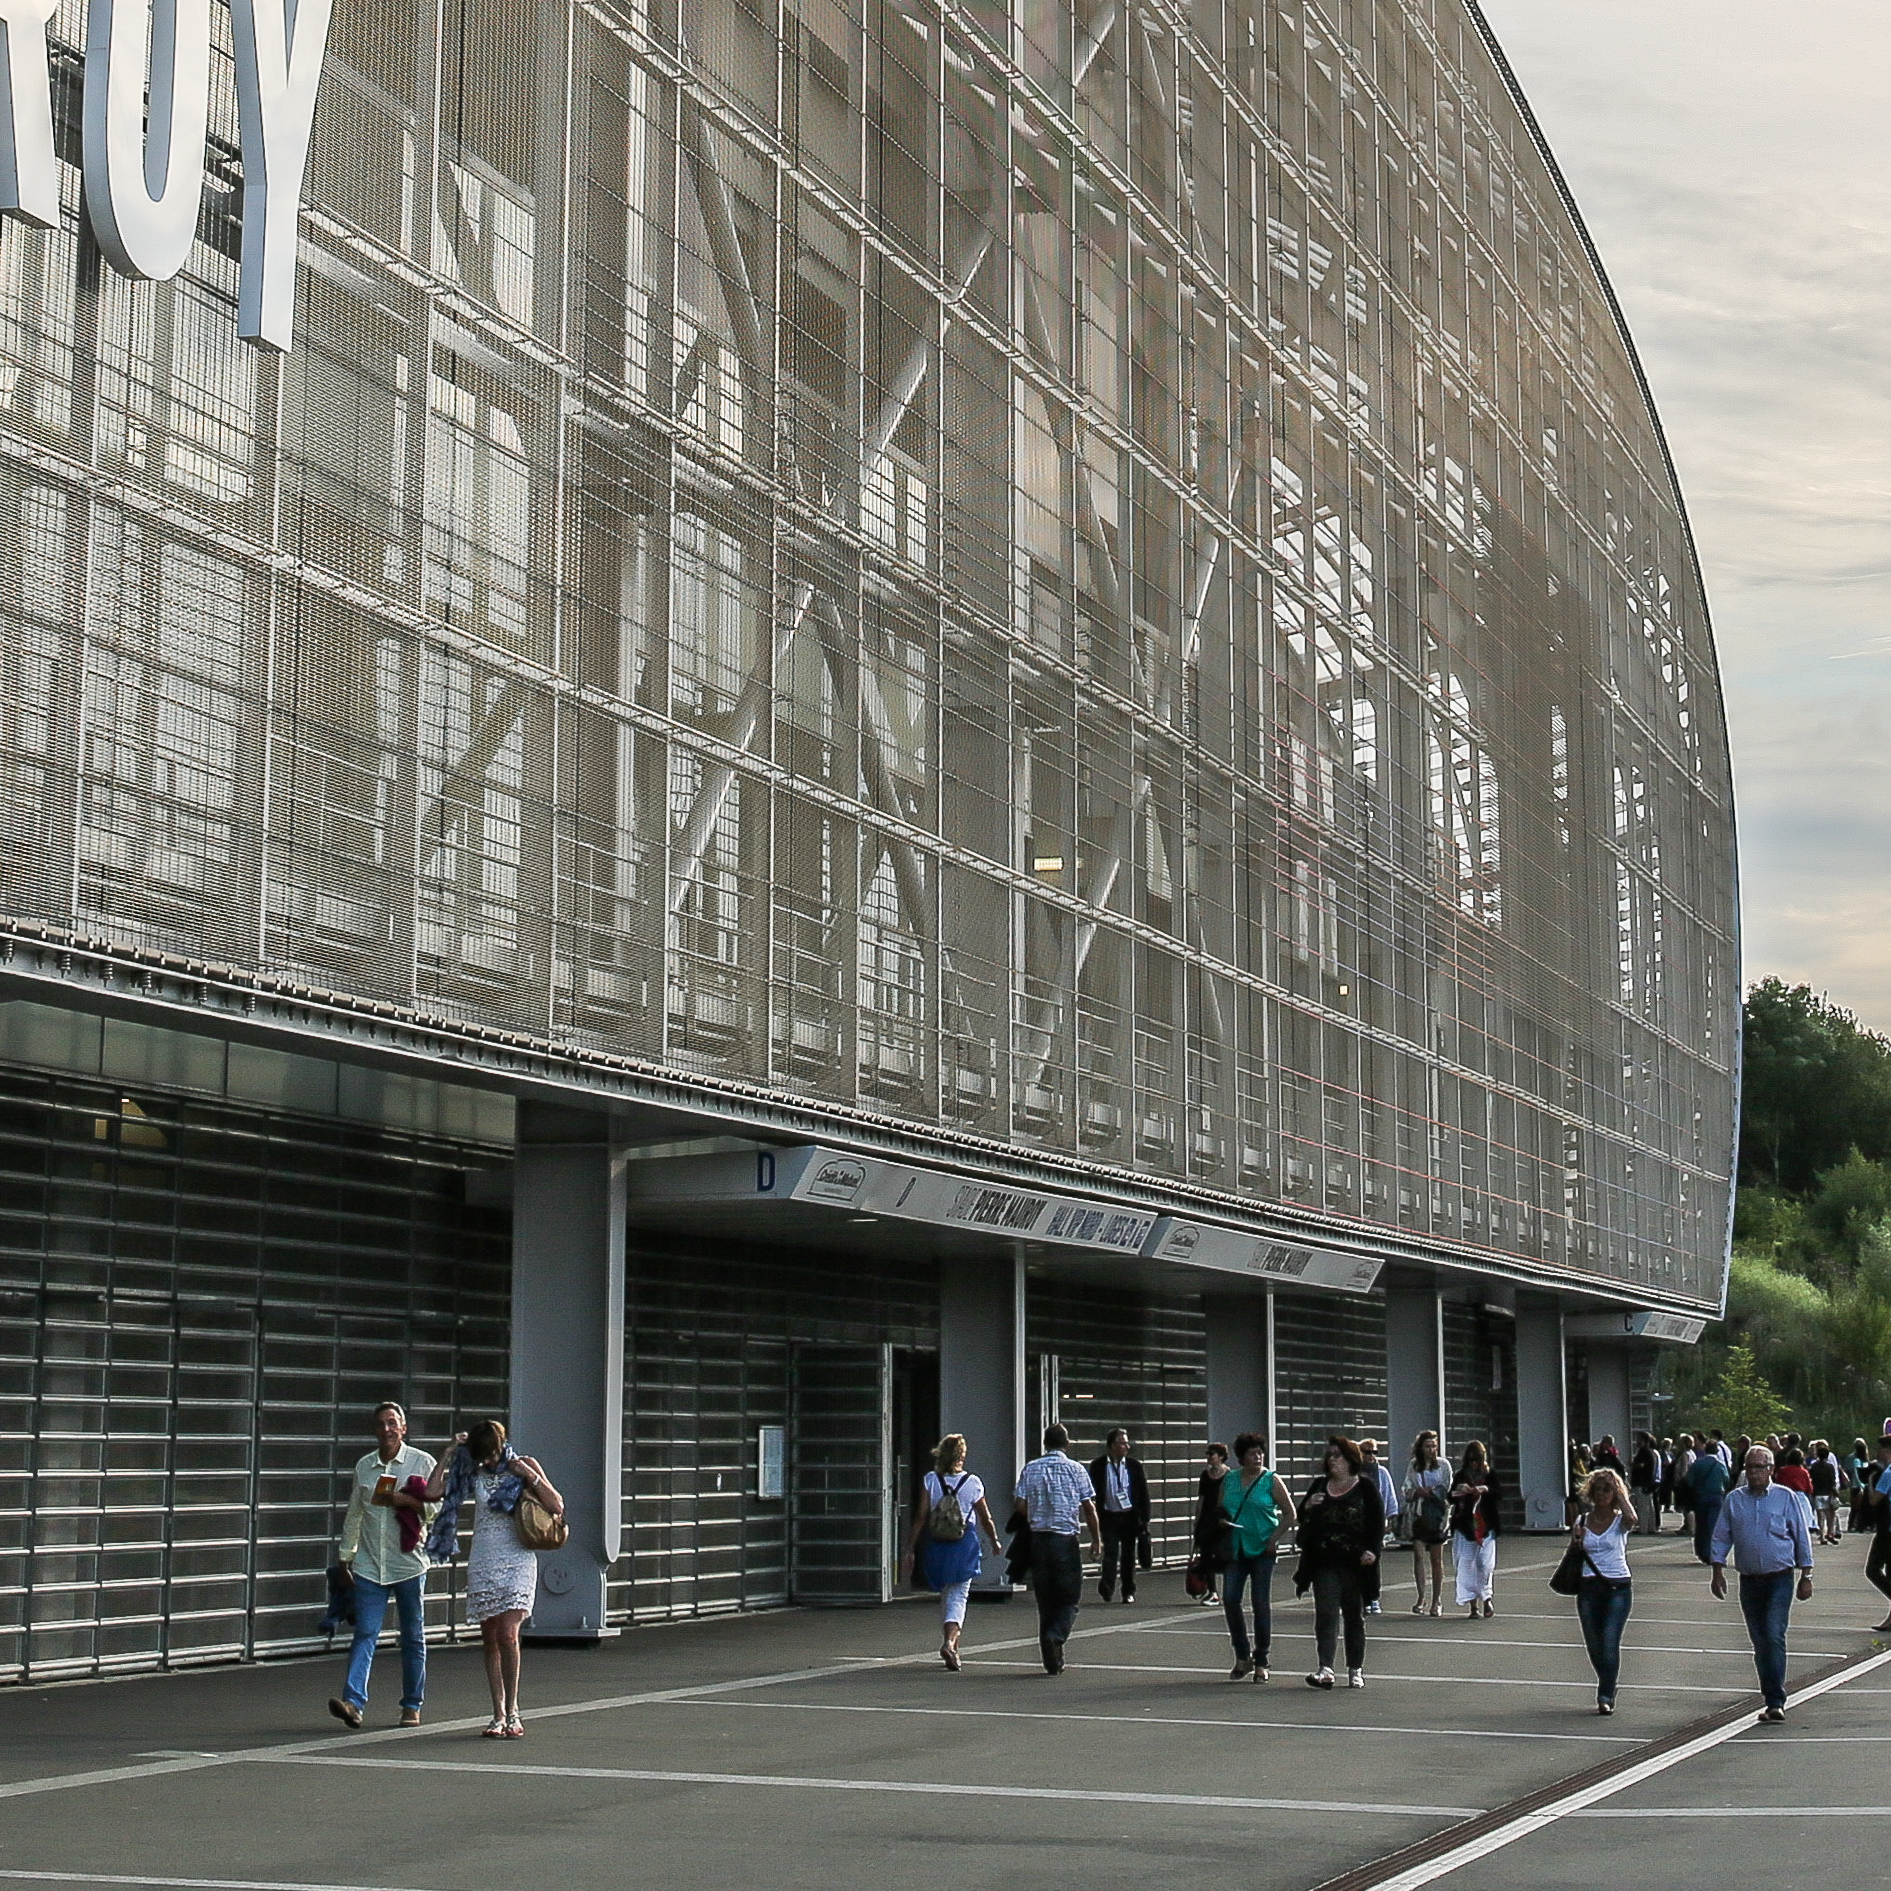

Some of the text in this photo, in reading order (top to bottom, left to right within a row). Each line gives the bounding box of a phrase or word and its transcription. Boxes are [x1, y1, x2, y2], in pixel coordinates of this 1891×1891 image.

[757, 1151, 776, 1192] D
[968, 1189, 1013, 1226] PIERRE
[999, 1193, 1049, 1231] MAUROY
[1624, 1313, 1633, 1331] C
